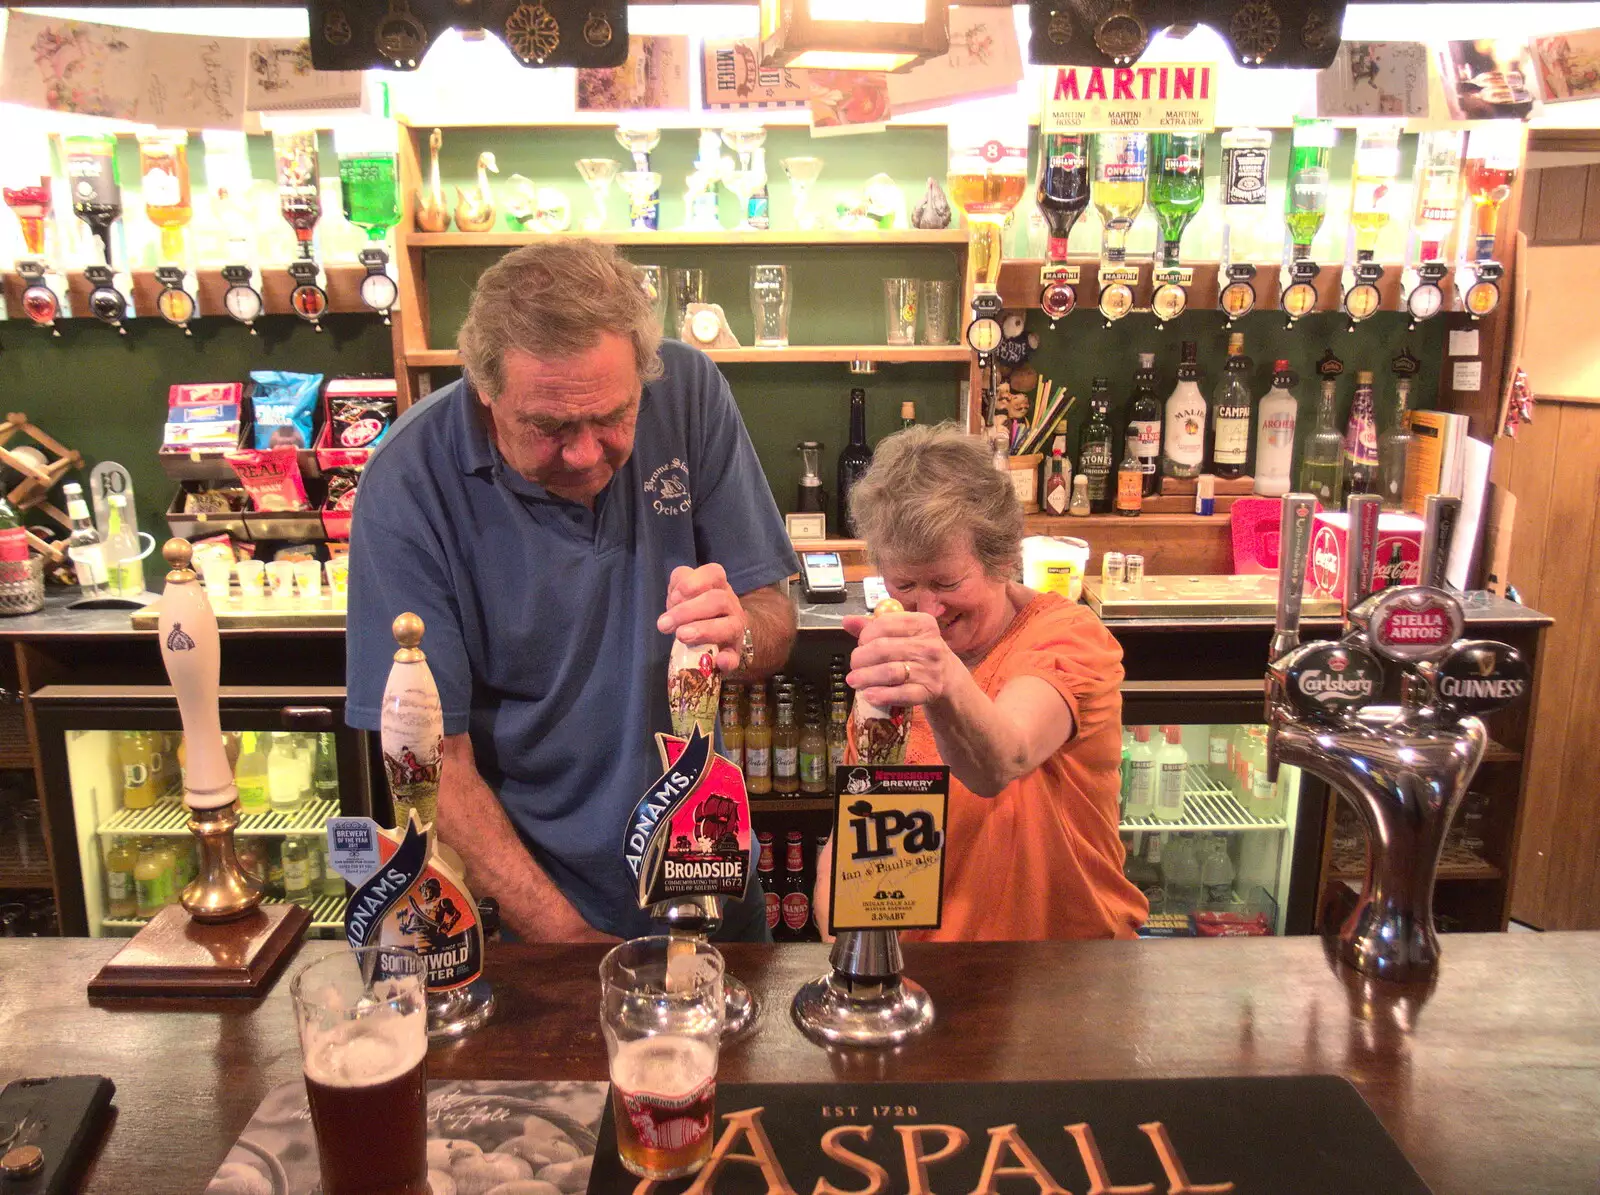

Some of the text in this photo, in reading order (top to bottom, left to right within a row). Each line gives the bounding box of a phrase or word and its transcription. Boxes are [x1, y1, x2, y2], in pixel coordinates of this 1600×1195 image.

[716, 50, 736, 90] MUCH
[1054, 66, 1210, 101] MARTINI
[1052, 111, 1086, 119] MARTINI
[1107, 111, 1142, 119] MARTINI
[1165, 110, 1200, 118] MARTINI
[1160, 118, 1186, 126] EXTRA
[1106, 165, 1142, 175] CINZANO
[1174, 408, 1205, 420] MALI
[1220, 406, 1250, 418] CAMPA
[1081, 455, 1112, 465] STONES
[236, 463, 285, 479] REAL
[653, 493, 692, 515] Cycle Cl
[1391, 614, 1443, 626] STELLA
[1389, 626, 1443, 639] ARTOIS
[1299, 669, 1373, 699] Carlsberg
[1440, 676, 1525, 698] GUINNESS
[336, 829, 368, 838] BREWERY
[664, 860, 743, 879] BROADSIDE
[876, 858, 913, 875] Paul's
[722, 878, 743, 887] 1672
[427, 969, 455, 981] TER
[822, 1105, 859, 1117] EST
[632, 1106, 1236, 1195] ASPALL
